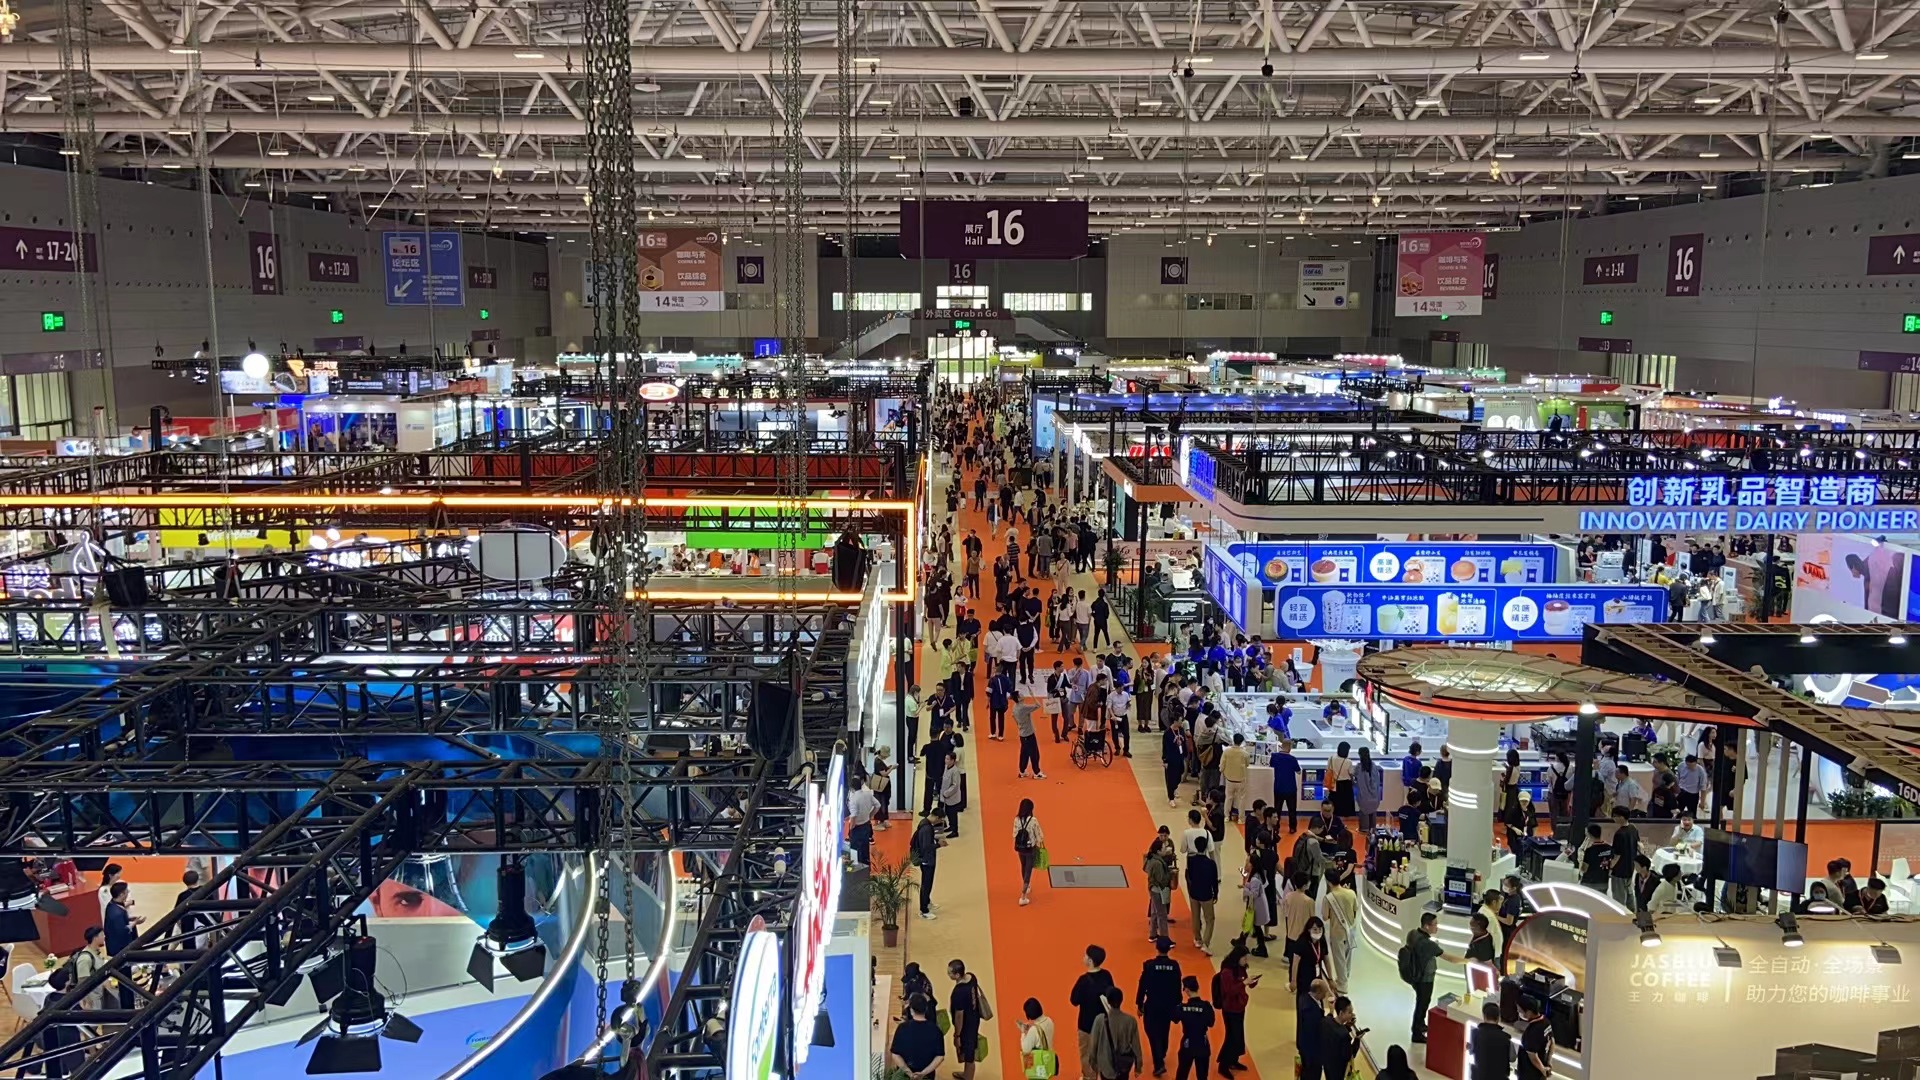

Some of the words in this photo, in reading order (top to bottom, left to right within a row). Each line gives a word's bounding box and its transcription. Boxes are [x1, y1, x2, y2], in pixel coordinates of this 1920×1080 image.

[965, 224, 983, 234] 展厅
[987, 209, 1025, 246] 16
[638, 234, 655, 247] 16
[965, 236, 983, 245] Hall
[1401, 240, 1418, 252] 16
[46, 241, 78, 261] 17-20
[404, 245, 417, 253] 16
[257, 245, 275, 279] 16
[1674, 247, 1694, 280] 16
[333, 262, 350, 276] 17-20
[954, 264, 971, 279] 16
[1484, 263, 1495, 288] 16
[1611, 262, 1625, 277] 1-14
[655, 296, 670, 307] 14
[1413, 301, 1428, 312] 14
[925, 309, 951, 318] 外卖区
[954, 309, 975, 317] Grab
[985, 309, 998, 317] Go
[1628, 476, 1877, 506] 创新乳品智造商
[1579, 511, 1728, 530] INNOVATIVE
[1735, 511, 1807, 530] DAIRY
[1816, 511, 1919, 530] PIONEER
[1289, 603, 1308, 612] 轻宜
[1289, 612, 1308, 622] 精选
[1511, 613, 1530, 622] 精选
[1629, 972, 1711, 987] COFFEE
[1628, 991, 1709, 1002] 王力咖啡
[1745, 984, 1911, 1003] 助力您的咖啡事业
